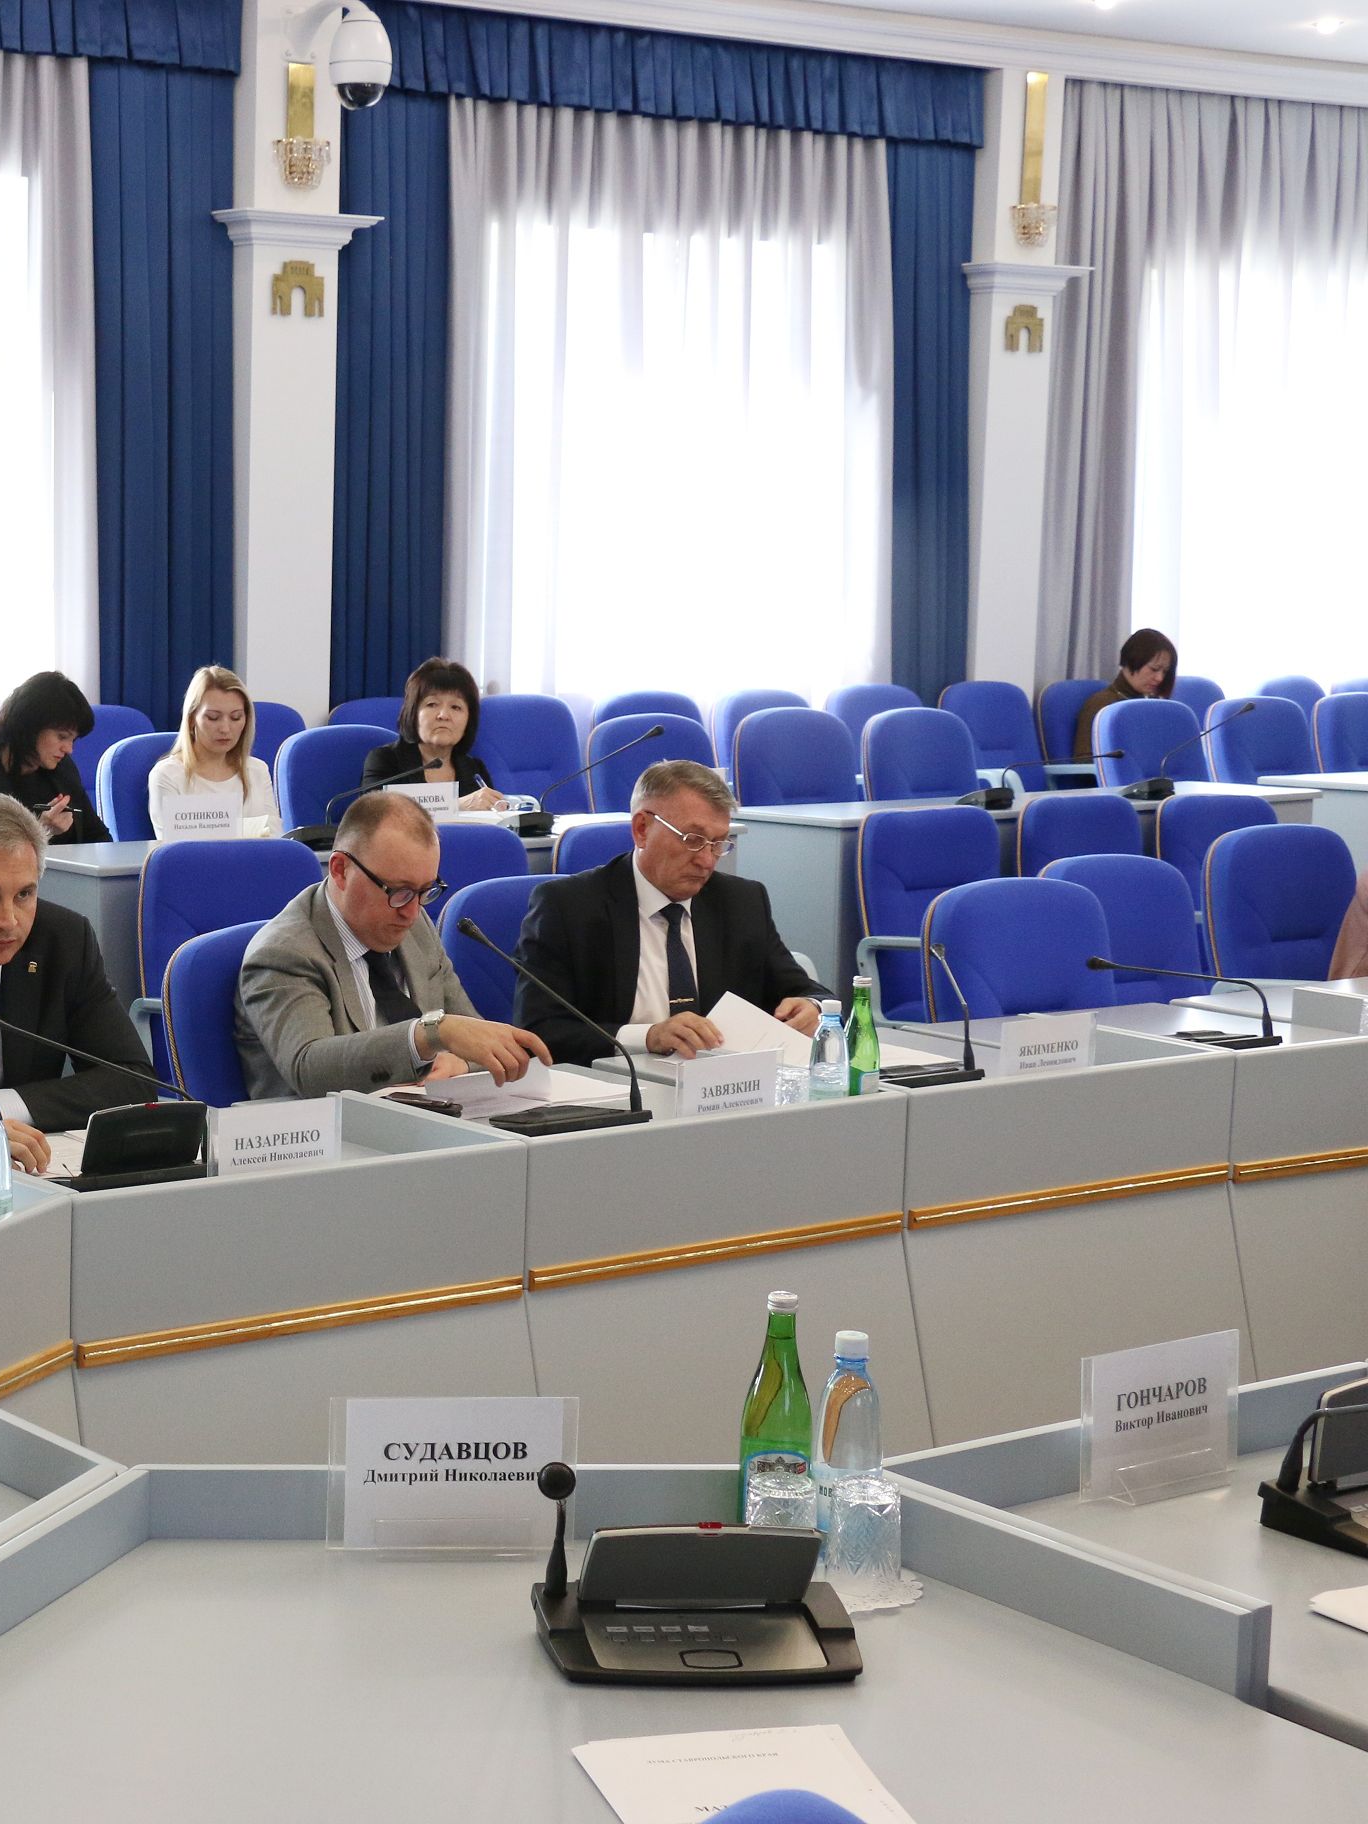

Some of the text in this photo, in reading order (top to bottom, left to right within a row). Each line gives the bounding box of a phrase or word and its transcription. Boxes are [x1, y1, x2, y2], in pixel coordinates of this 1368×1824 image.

[174, 811, 230, 821] СОТНИКОВА
[1019, 1040, 1079, 1057] ЯКИМЕНКО
[701, 1079, 760, 1099] ЗАВЯЗКИН
[697, 1096, 763, 1113] Роман Алексеевич
[233, 1129, 321, 1151] НАЗАРЕНКО
[231, 1149, 324, 1167] Алексей Николаевич
[1116, 1377, 1207, 1412] ГОНЧАРОВ
[1115, 1404, 1208, 1433] Виктор Иванович
[383, 1441, 528, 1464] СУДАВЦОВ
[363, 1468, 539, 1486] Дмитрий Николаеви
